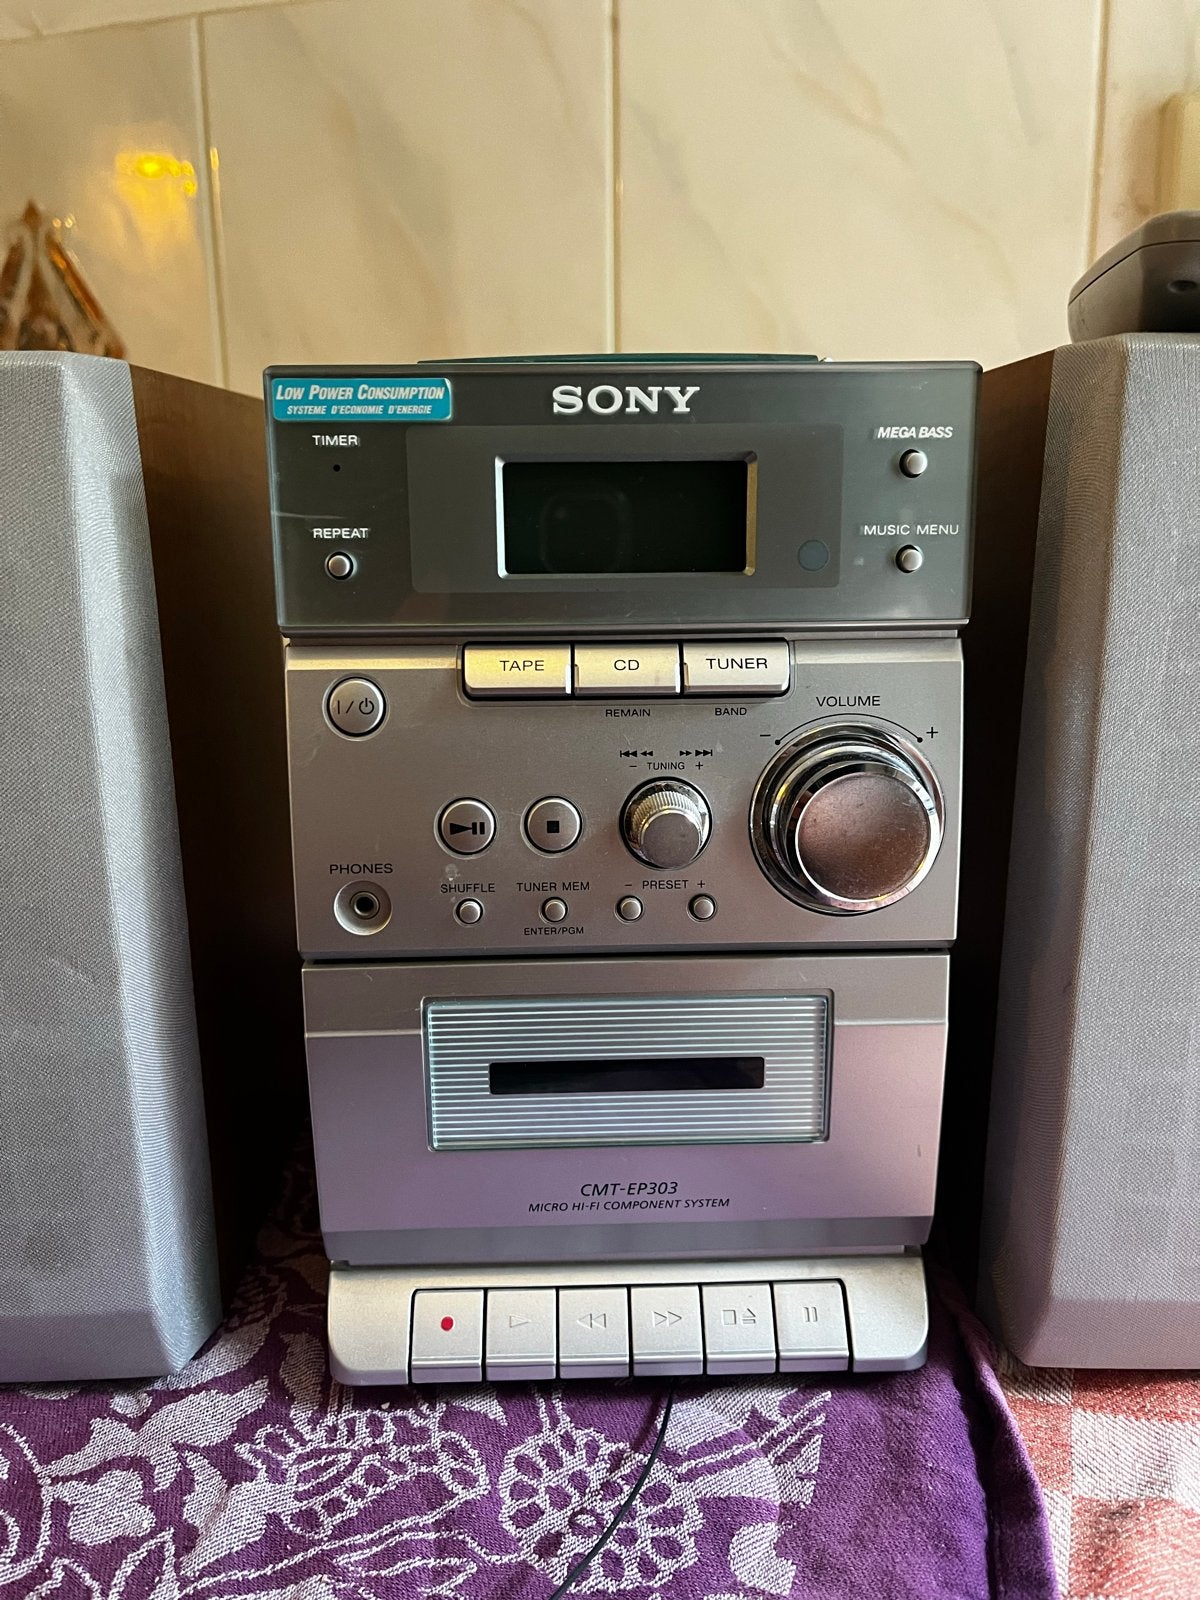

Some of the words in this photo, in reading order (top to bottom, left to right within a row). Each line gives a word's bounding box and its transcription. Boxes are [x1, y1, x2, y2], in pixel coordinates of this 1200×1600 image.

[552, 385, 700, 415] SONY
[287, 405, 327, 415] SYSTEME
[331, 405, 383, 415] D'ECONOMIE
[388, 405, 432, 414] D'ENERGIE
[876, 426, 917, 439] MEGA
[918, 426, 954, 439] BASS
[312, 435, 359, 446] TIMER
[312, 528, 369, 539] REPEAT
[863, 524, 911, 536] MUSIC
[916, 524, 960, 536] MENU
[500, 659, 545, 672] TAPE
[613, 658, 640, 671] CD
[705, 656, 768, 670] TUNER
[815, 695, 881, 708] VOLUME
[605, 708, 651, 718] REMAIN
[714, 707, 748, 717] BAND
[647, 761, 686, 771] TUNING
[329, 863, 394, 875] PHONES
[440, 882, 496, 894] SHUFFLE
[516, 881, 558, 893] TUNER
[562, 881, 591, 892] MEM
[642, 879, 689, 890] PRESET
[523, 926, 585, 936] ENTER/PGM
[580, 1181, 679, 1197] CMT-EP303
[528, 1202, 568, 1213] MICRO
[572, 1202, 600, 1211] HI-FI
[603, 1199, 682, 1211] COMPONENT
[684, 1198, 731, 1208] SYSTEM
